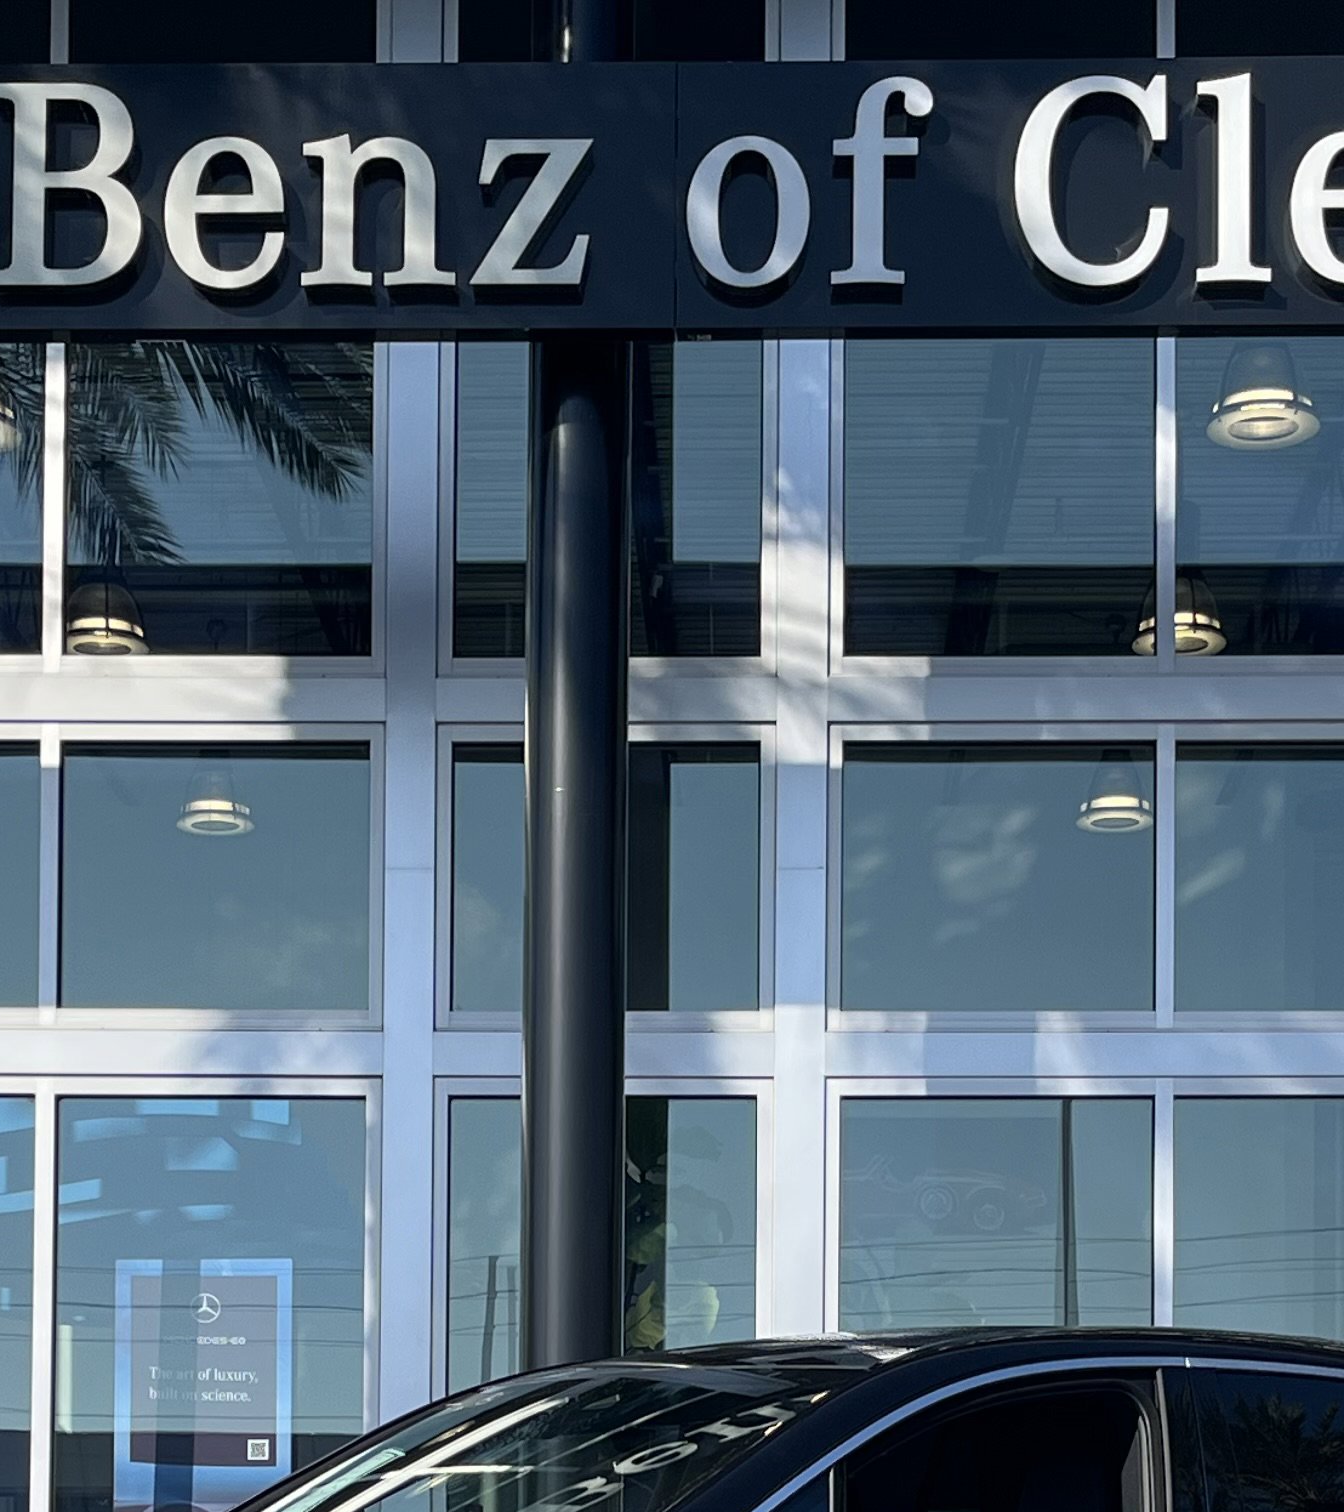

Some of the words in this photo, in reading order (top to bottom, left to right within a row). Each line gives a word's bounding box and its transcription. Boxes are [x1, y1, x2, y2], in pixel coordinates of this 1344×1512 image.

[686, 76, 934, 290] of
[197, 1367, 212, 1382] of
[213, 1368, 259, 1385] luxury,
[200, 1388, 252, 1403] science.
